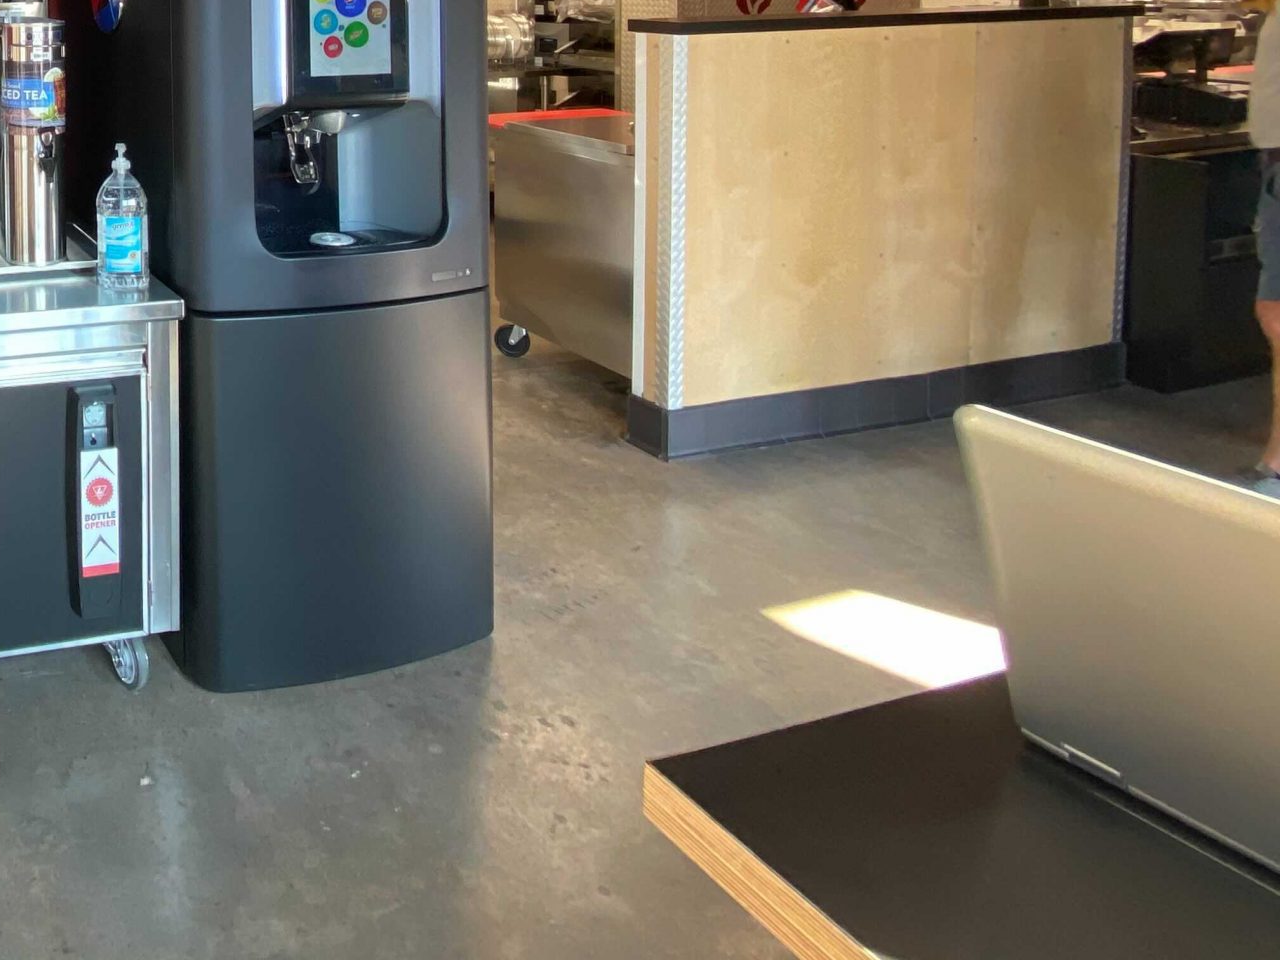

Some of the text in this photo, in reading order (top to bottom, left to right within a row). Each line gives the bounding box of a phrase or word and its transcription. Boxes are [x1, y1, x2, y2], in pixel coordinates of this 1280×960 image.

[1, 89, 48, 100] CED TEA
[84, 511, 116, 521] BOTTLE
[84, 519, 116, 529] OPENER
